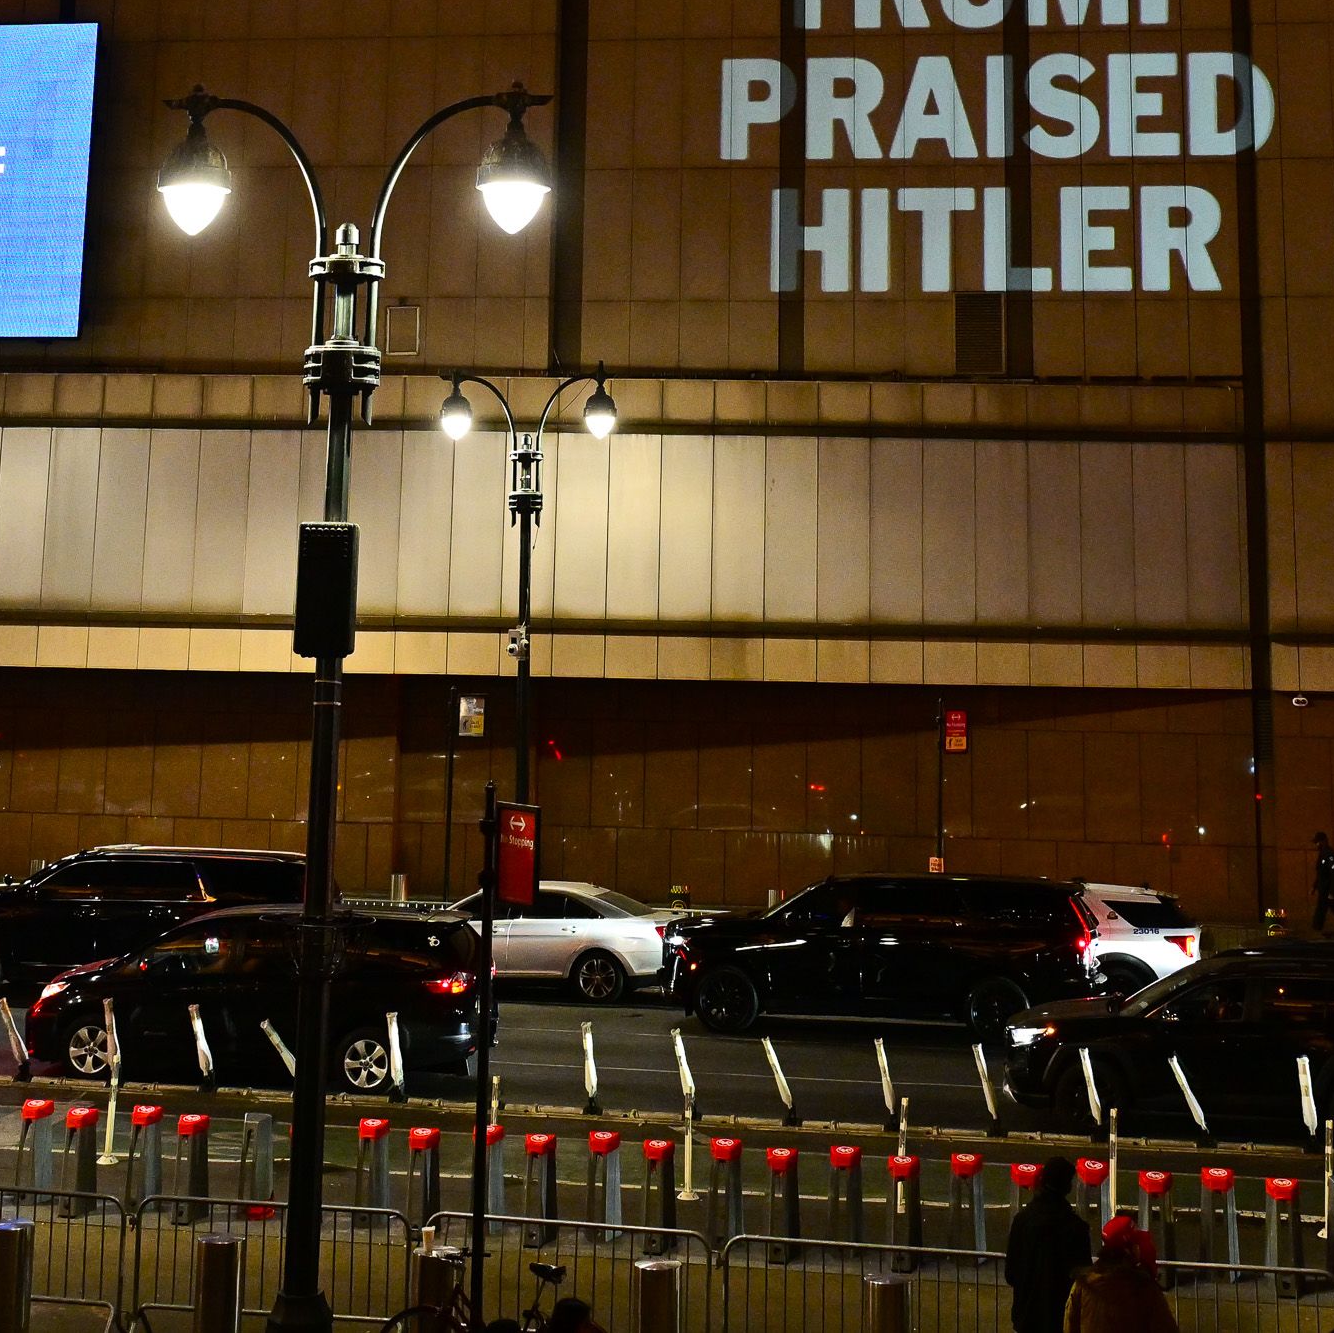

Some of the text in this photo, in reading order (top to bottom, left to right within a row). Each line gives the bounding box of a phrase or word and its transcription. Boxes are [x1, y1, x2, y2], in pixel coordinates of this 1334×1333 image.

[719, 51, 1276, 161] PRAISED
[769, 184, 1223, 293] HITLER
[509, 834, 534, 850] Stopping
